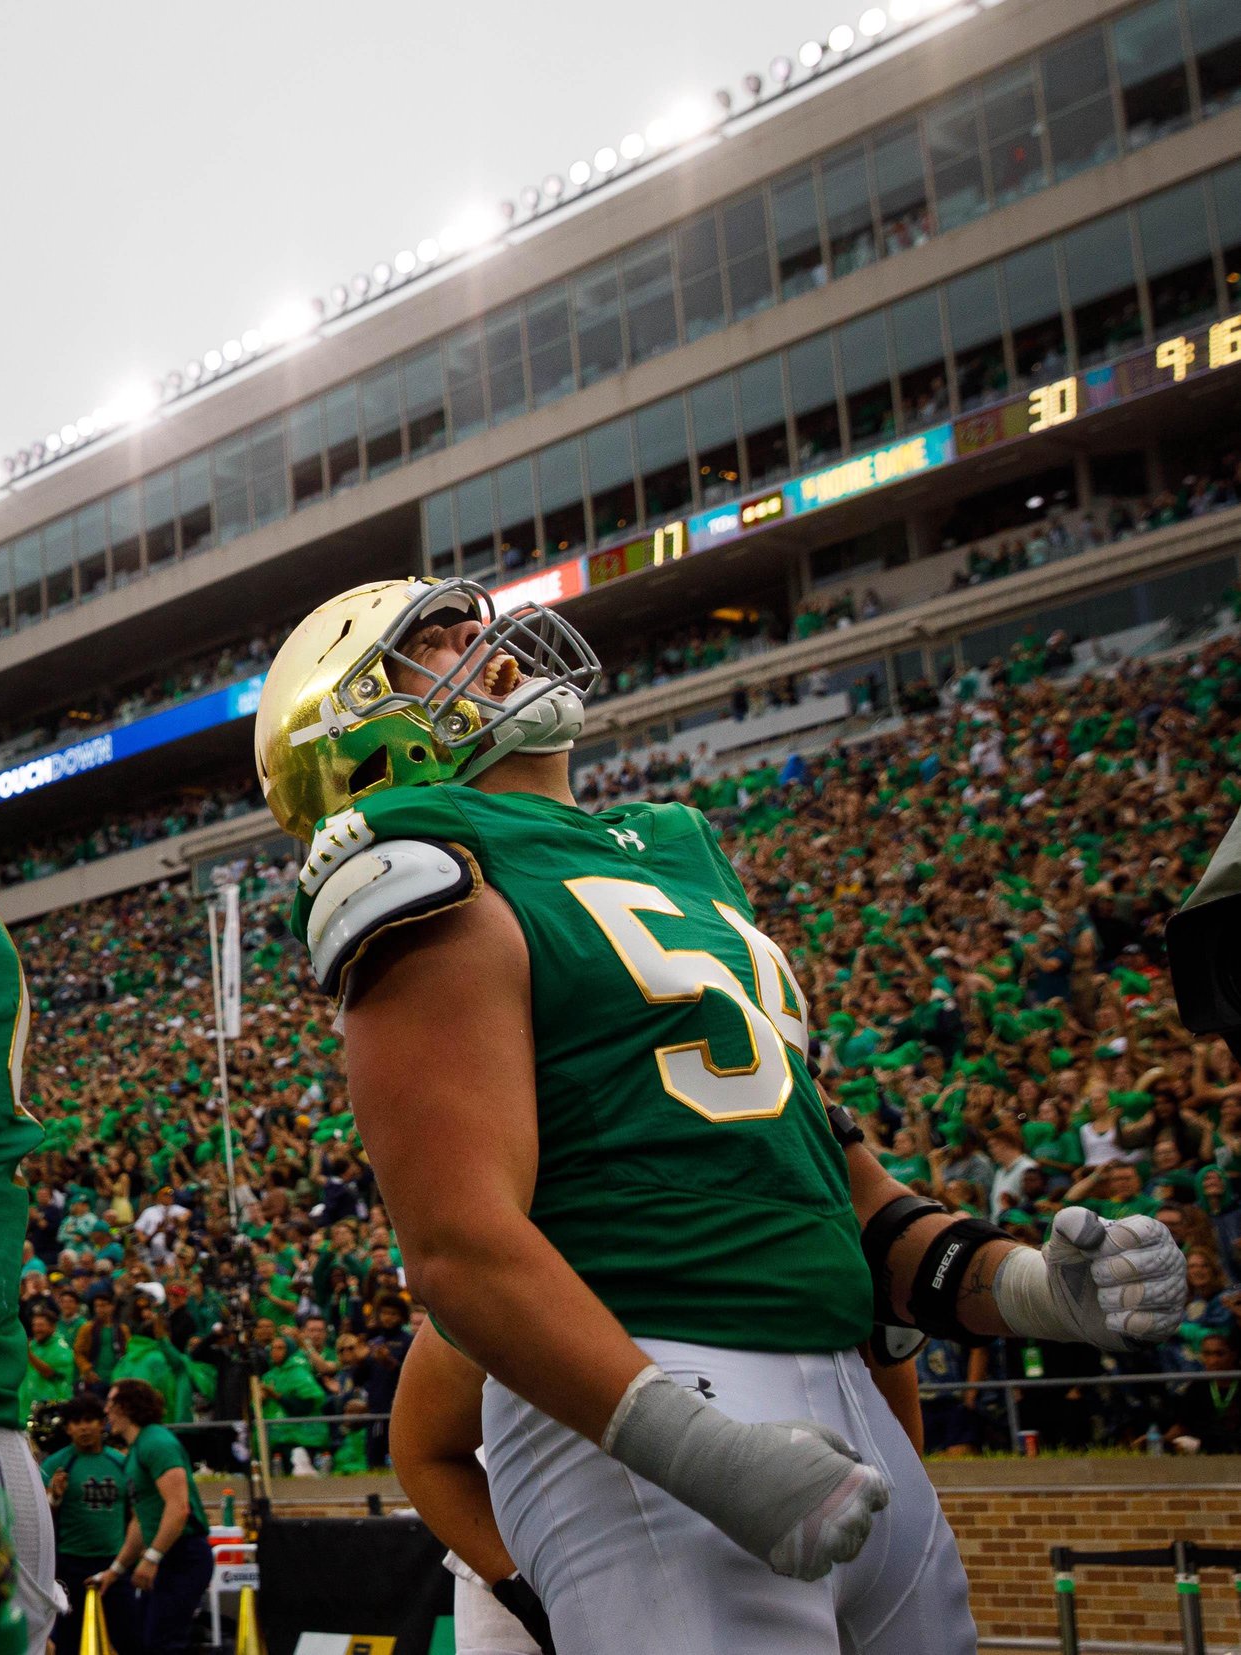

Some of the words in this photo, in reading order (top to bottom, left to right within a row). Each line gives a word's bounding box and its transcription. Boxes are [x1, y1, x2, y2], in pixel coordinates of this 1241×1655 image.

[1028, 375, 1078, 434] 30
[653, 520, 684, 567] 17
[563, 875, 809, 1124] 54
[931, 1242, 960, 1289] BREG
